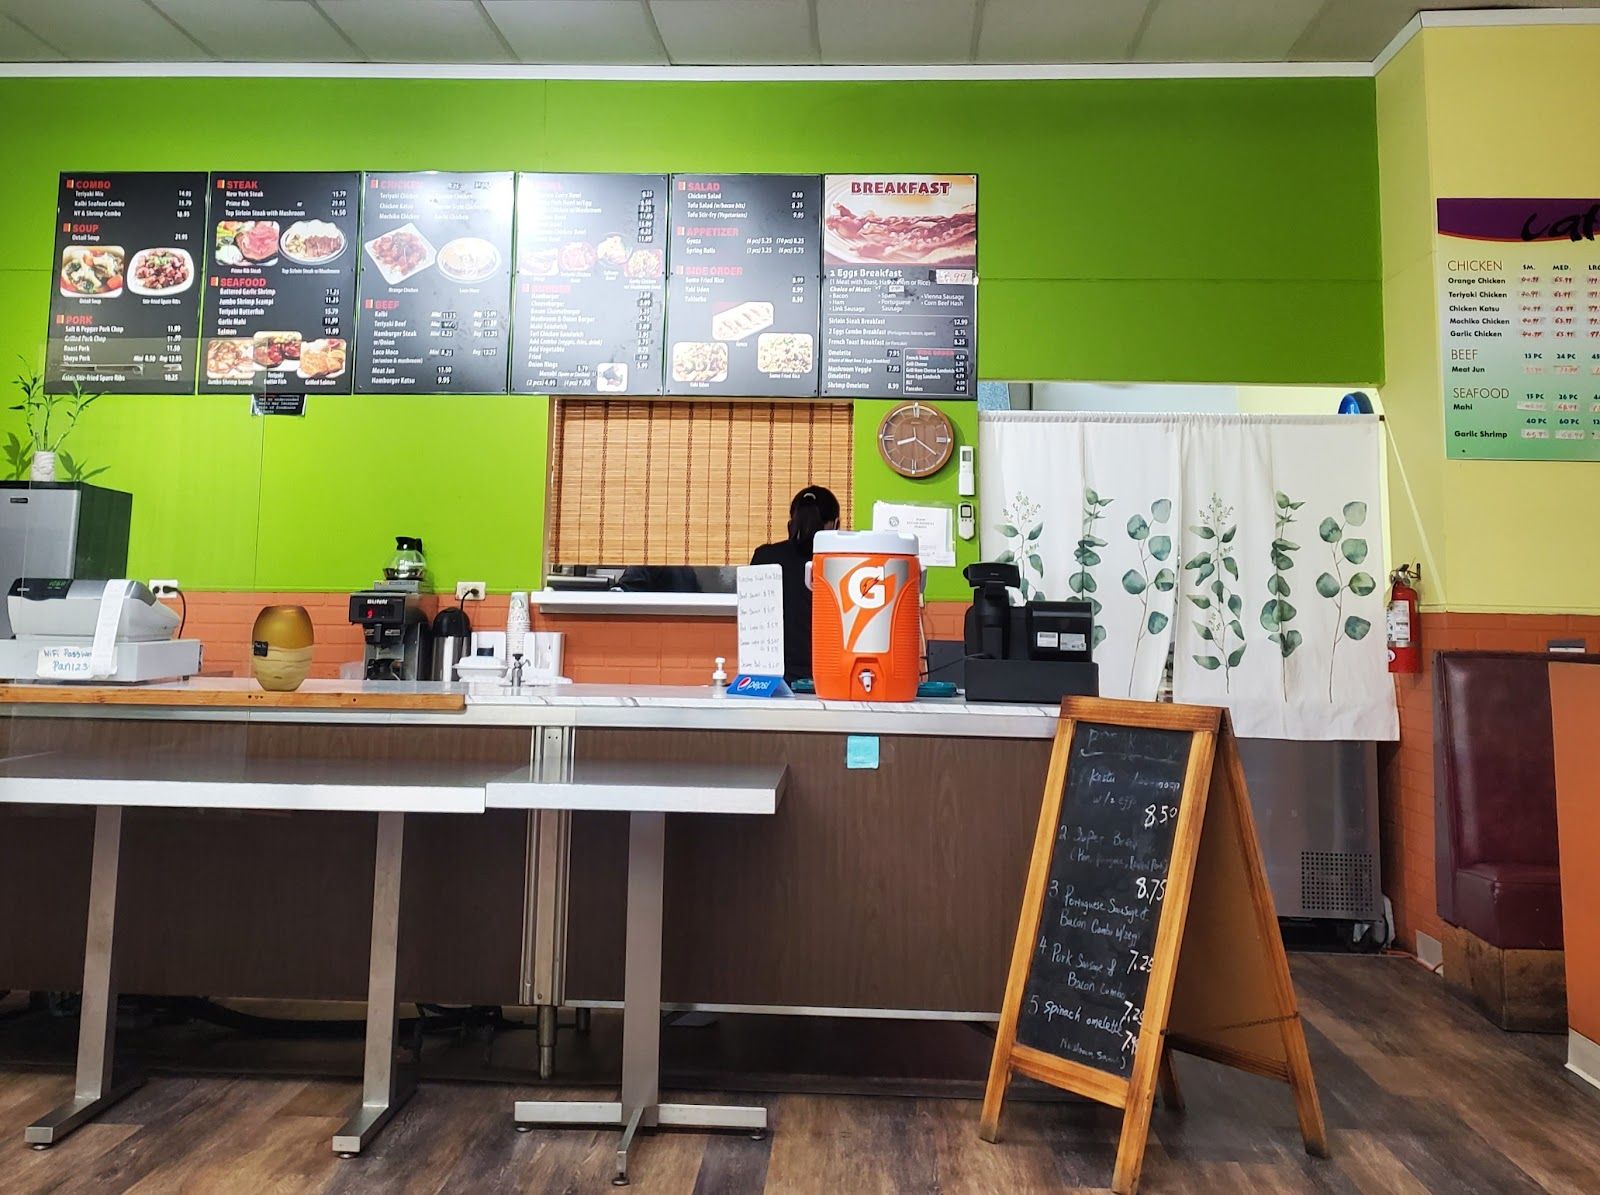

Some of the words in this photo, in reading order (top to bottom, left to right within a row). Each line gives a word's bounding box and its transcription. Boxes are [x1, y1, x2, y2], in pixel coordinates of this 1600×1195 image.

[76, 181, 111, 189] COMBO
[227, 181, 258, 189] STEAK
[687, 183, 720, 191] SALAD
[851, 182, 951, 195] BREAKFAST
[73, 224, 99, 232] SOUP
[687, 228, 738, 236] APPETIZER
[710, 267, 743, 275] ORDER
[1448, 260, 1503, 271] CHICKEN
[838, 269, 857, 277] Eggs
[220, 278, 266, 287] SEAFOOD
[375, 301, 399, 309] BEEF
[65, 316, 93, 324] PORK
[80, 326, 98, 334] Pepper
[99, 325, 110, 333] Pork
[111, 325, 124, 333] Chop
[1451, 349, 1478, 360] BEEF
[1453, 388, 1510, 399] SEAFOOD
[849, 566, 886, 609] G
[53, 660, 89, 672] Pan123
[747, 680, 772, 691] pepsi
[1048, 879, 1058, 897] 3
[1136, 877, 1168, 904] 8.75
[1064, 884, 1105, 913] Portuguese
[1060, 909, 1087, 930] Bacon
[1051, 943, 1073, 967] Pork
[1067, 971, 1095, 993] Bacon
[1028, 995, 1039, 1015] 5
